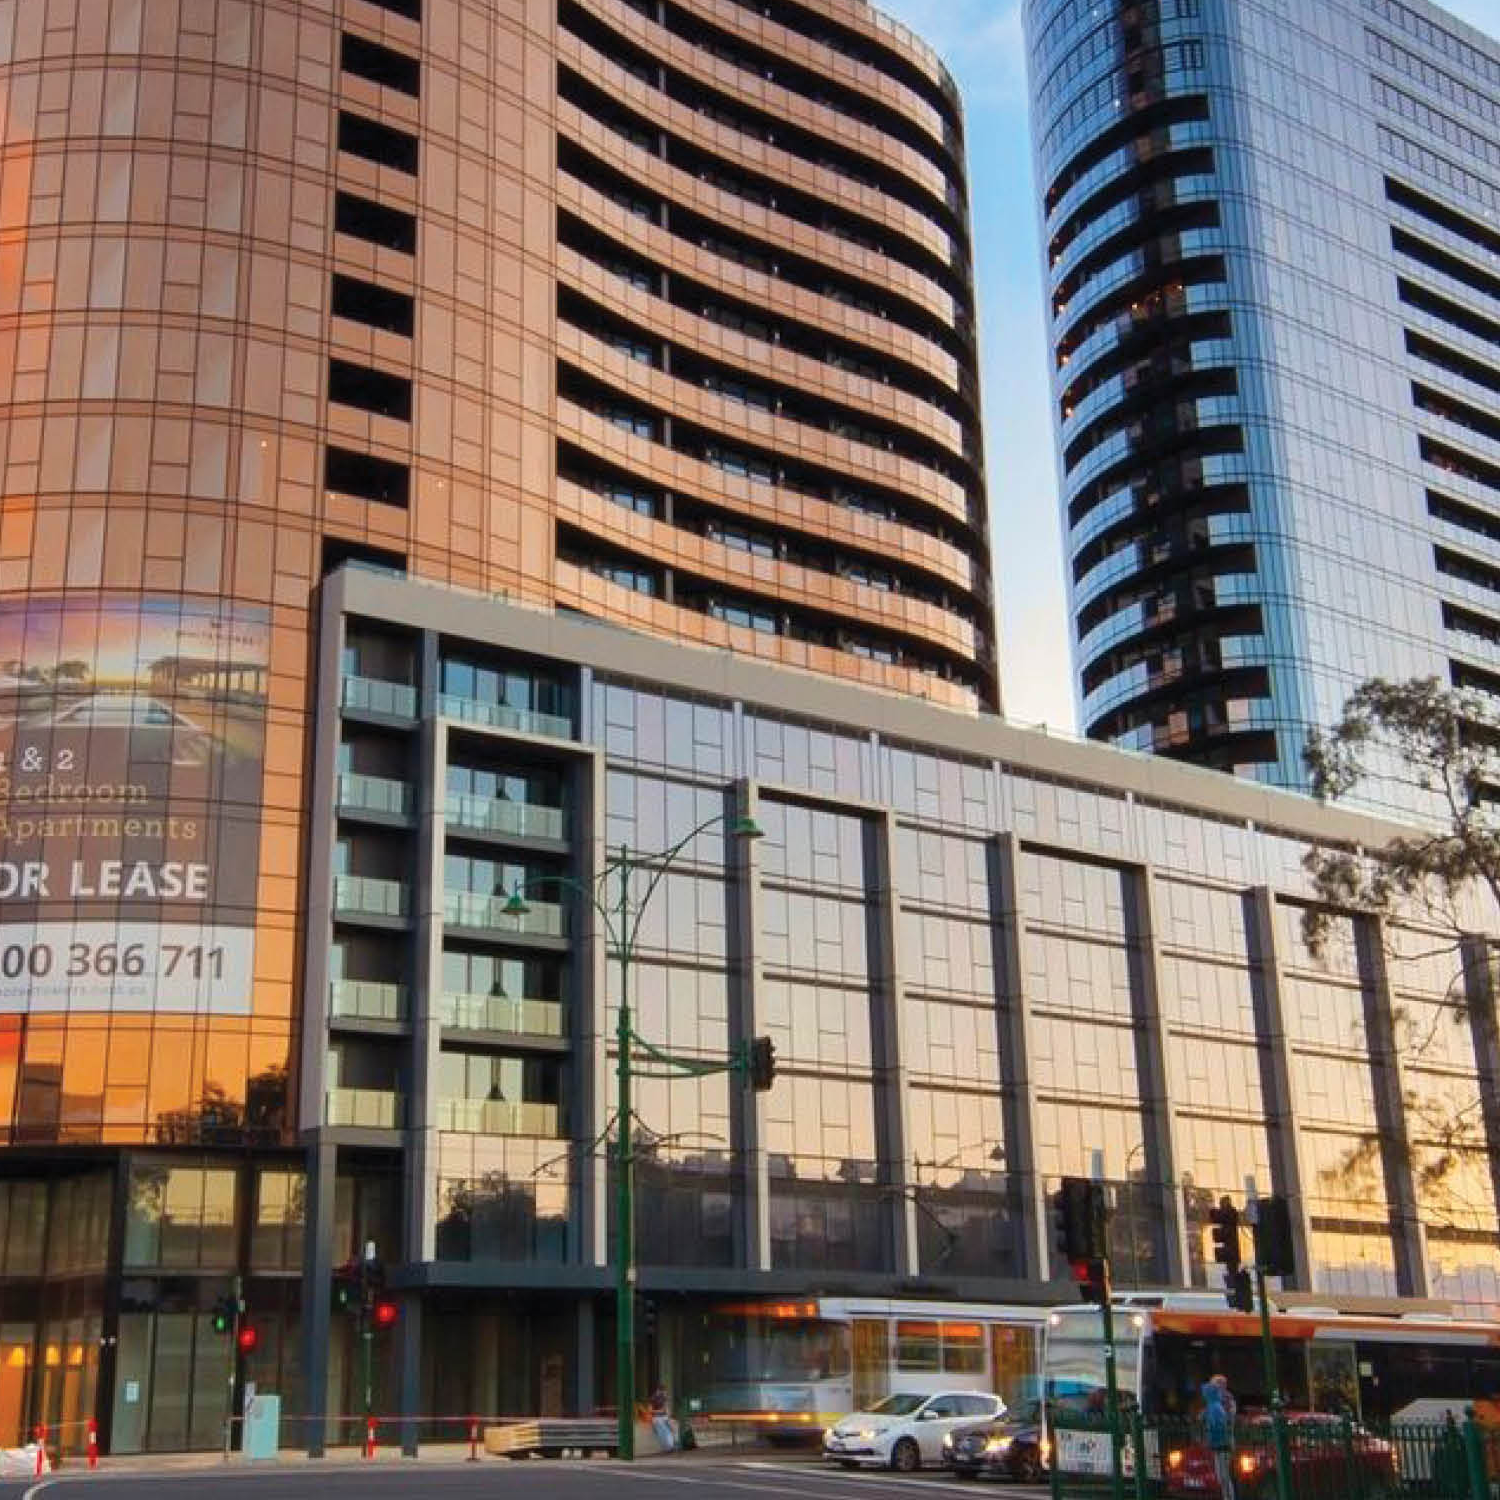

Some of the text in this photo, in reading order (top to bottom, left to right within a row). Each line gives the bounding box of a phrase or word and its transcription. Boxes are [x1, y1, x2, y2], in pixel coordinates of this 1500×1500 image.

[20, 746, 43, 772] &
[56, 749, 75, 770] 2
[69, 860, 209, 899] LEASE
[66, 943, 145, 978] 366
[160, 945, 224, 980] 711
